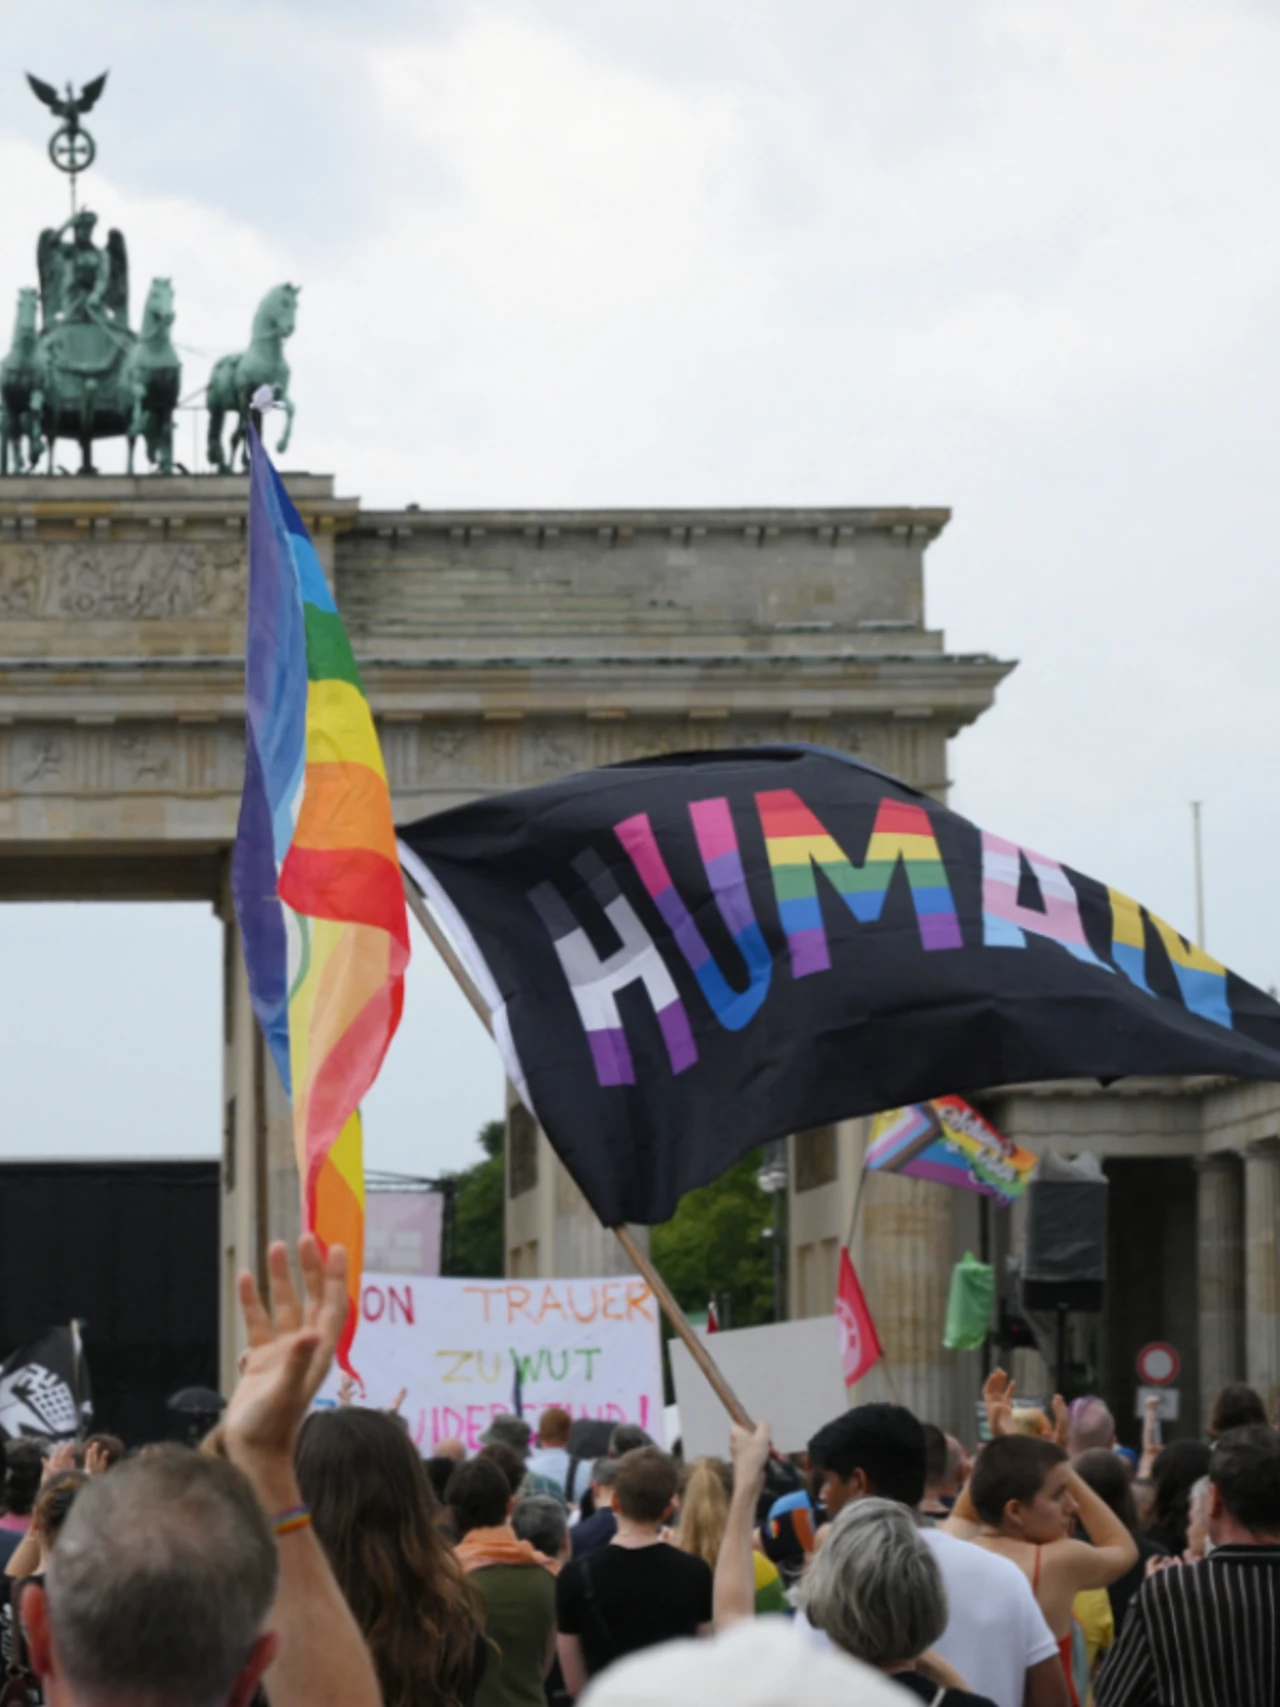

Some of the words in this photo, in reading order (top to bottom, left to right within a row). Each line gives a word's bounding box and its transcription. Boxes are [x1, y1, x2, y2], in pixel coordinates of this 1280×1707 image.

[528, 788, 1233, 1087] HUMAN
[362, 1285, 416, 1325] ON
[462, 1281, 656, 1325] TRAUER
[436, 1350, 501, 1383] ZU
[509, 1346, 602, 1385] WUT
